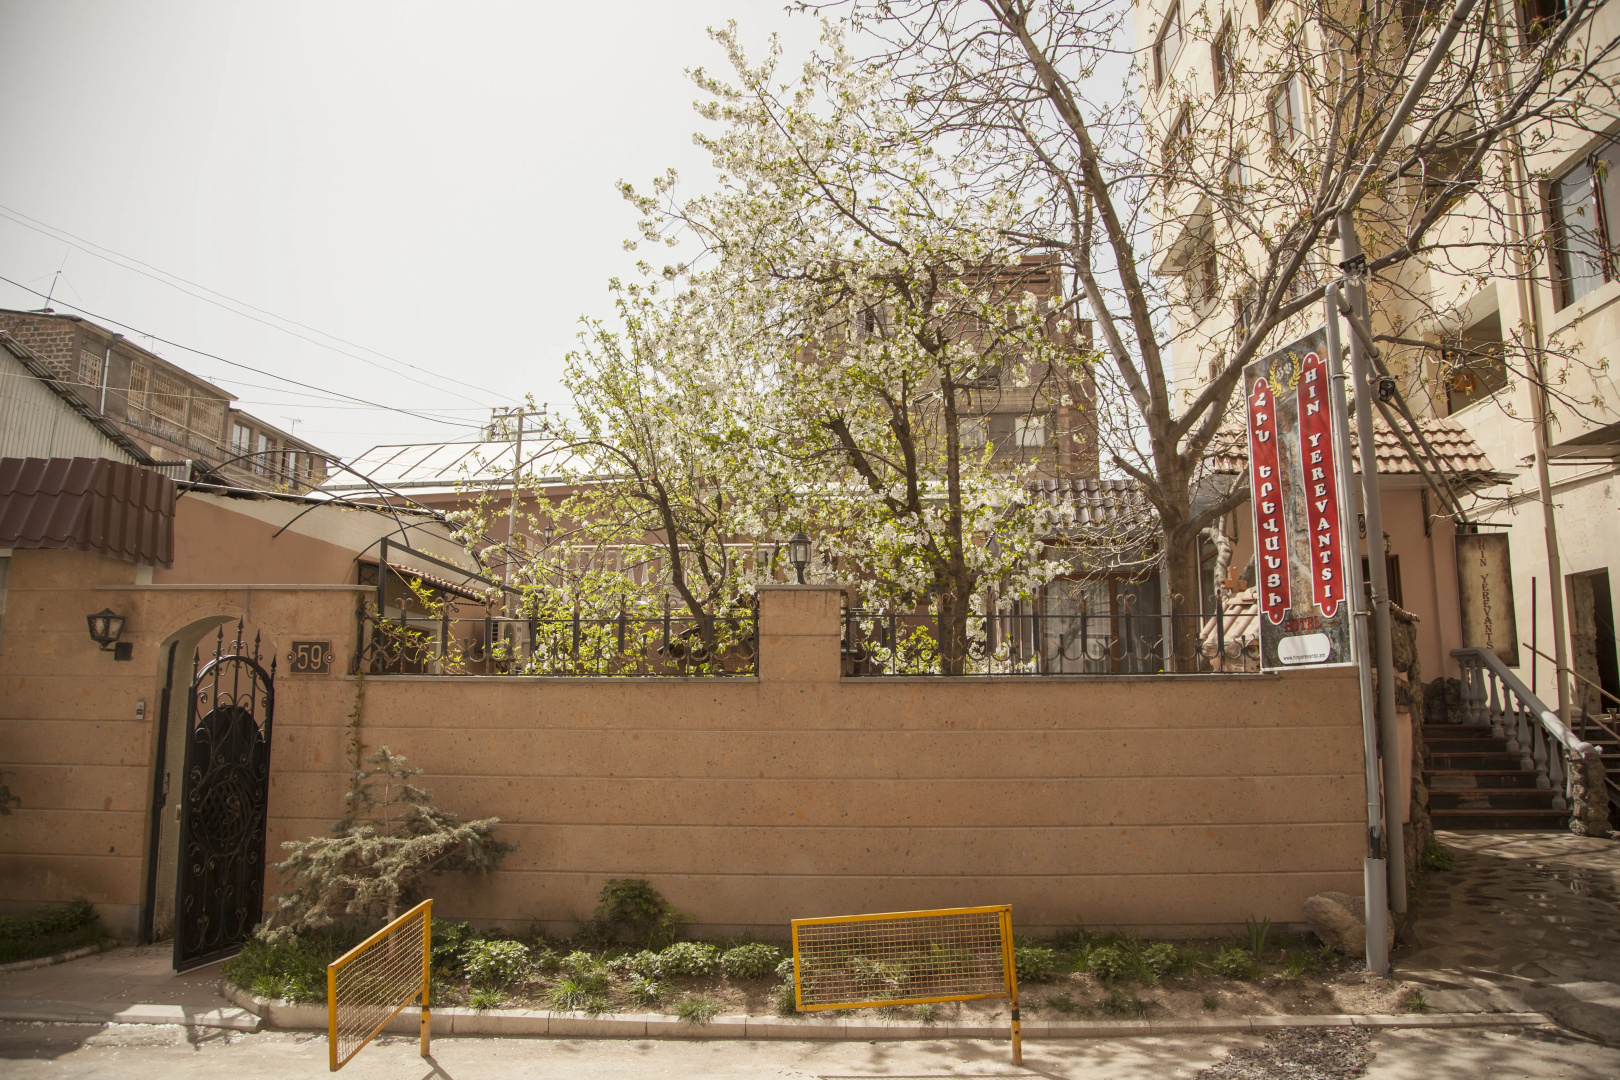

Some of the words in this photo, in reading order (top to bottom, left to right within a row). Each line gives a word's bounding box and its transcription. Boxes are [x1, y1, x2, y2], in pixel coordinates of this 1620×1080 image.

[1305, 368, 1320, 416] HIN
[1308, 432, 1333, 598] YEREVANTSI
[1478, 541, 1487, 567] HIN
[1285, 616, 1322, 632] HOTEL
[1480, 573, 1494, 650] YEREVANTS
[297, 644, 322, 670] 59
